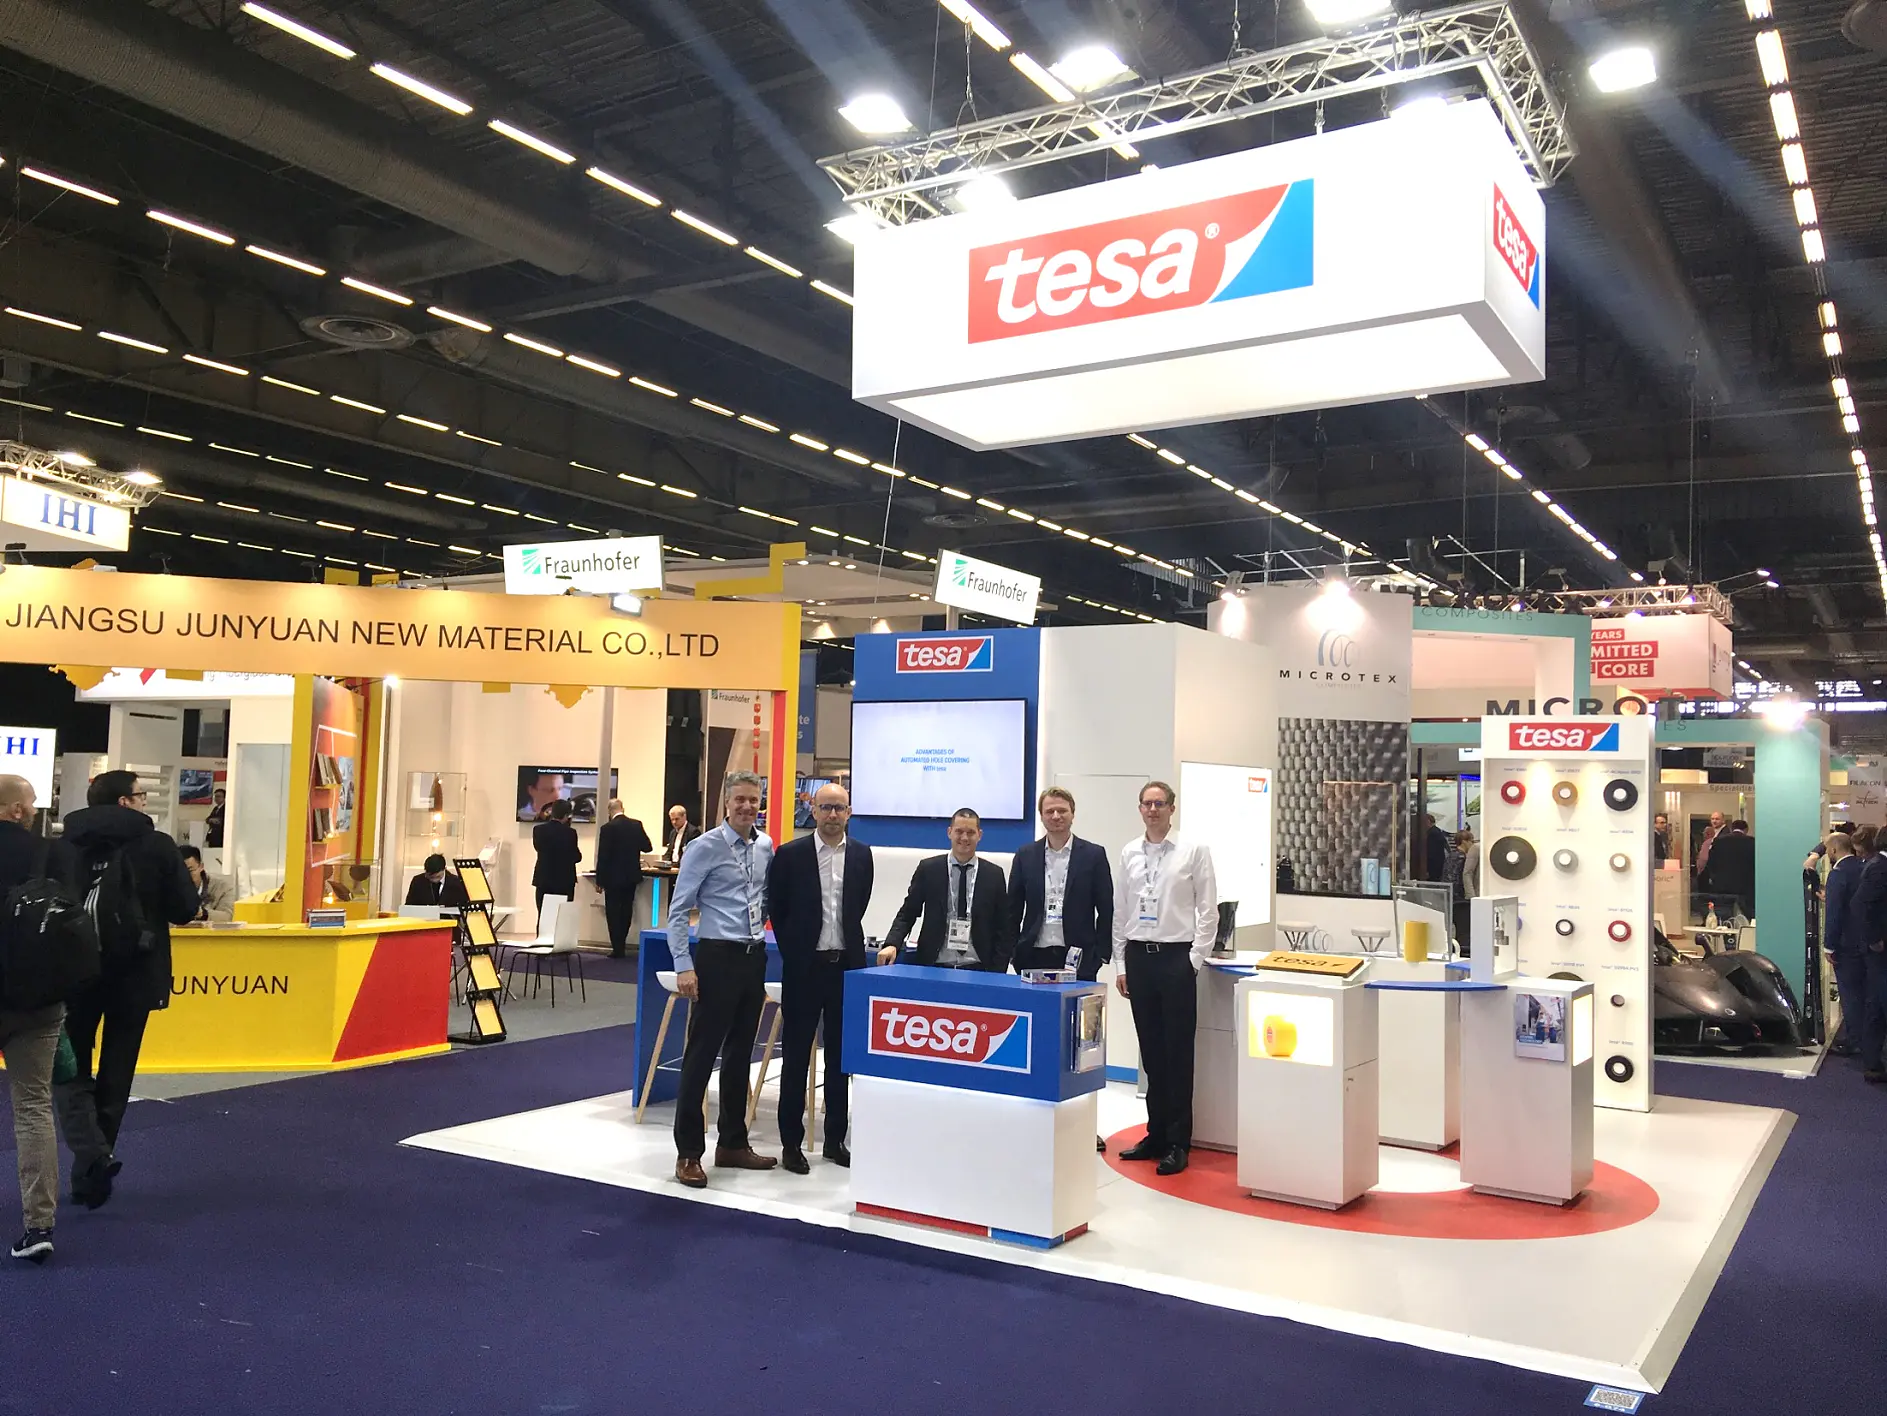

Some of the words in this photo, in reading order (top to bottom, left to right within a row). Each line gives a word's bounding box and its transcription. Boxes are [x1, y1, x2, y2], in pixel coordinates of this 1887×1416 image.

[40, 493, 98, 536] IHI
[545, 550, 641, 575] Fraunhofer
[967, 571, 1028, 602] Fraunhofer
[1421, 605, 1533, 621] COMPOSITES
[5, 603, 164, 635] JIANGSU
[176, 612, 339, 643] JUNYUAN
[351, 620, 428, 647] NEW
[438, 625, 593, 654] MATERIAL
[602, 631, 719, 660] CO.,LTD
[1279, 669, 1397, 684] MICROTEX
[1602, 663, 1649, 676] CORE
[719, 692, 750, 704] Fraunhofer
[0, 737, 40, 756] HI
[1273, 955, 1327, 967] tesa
